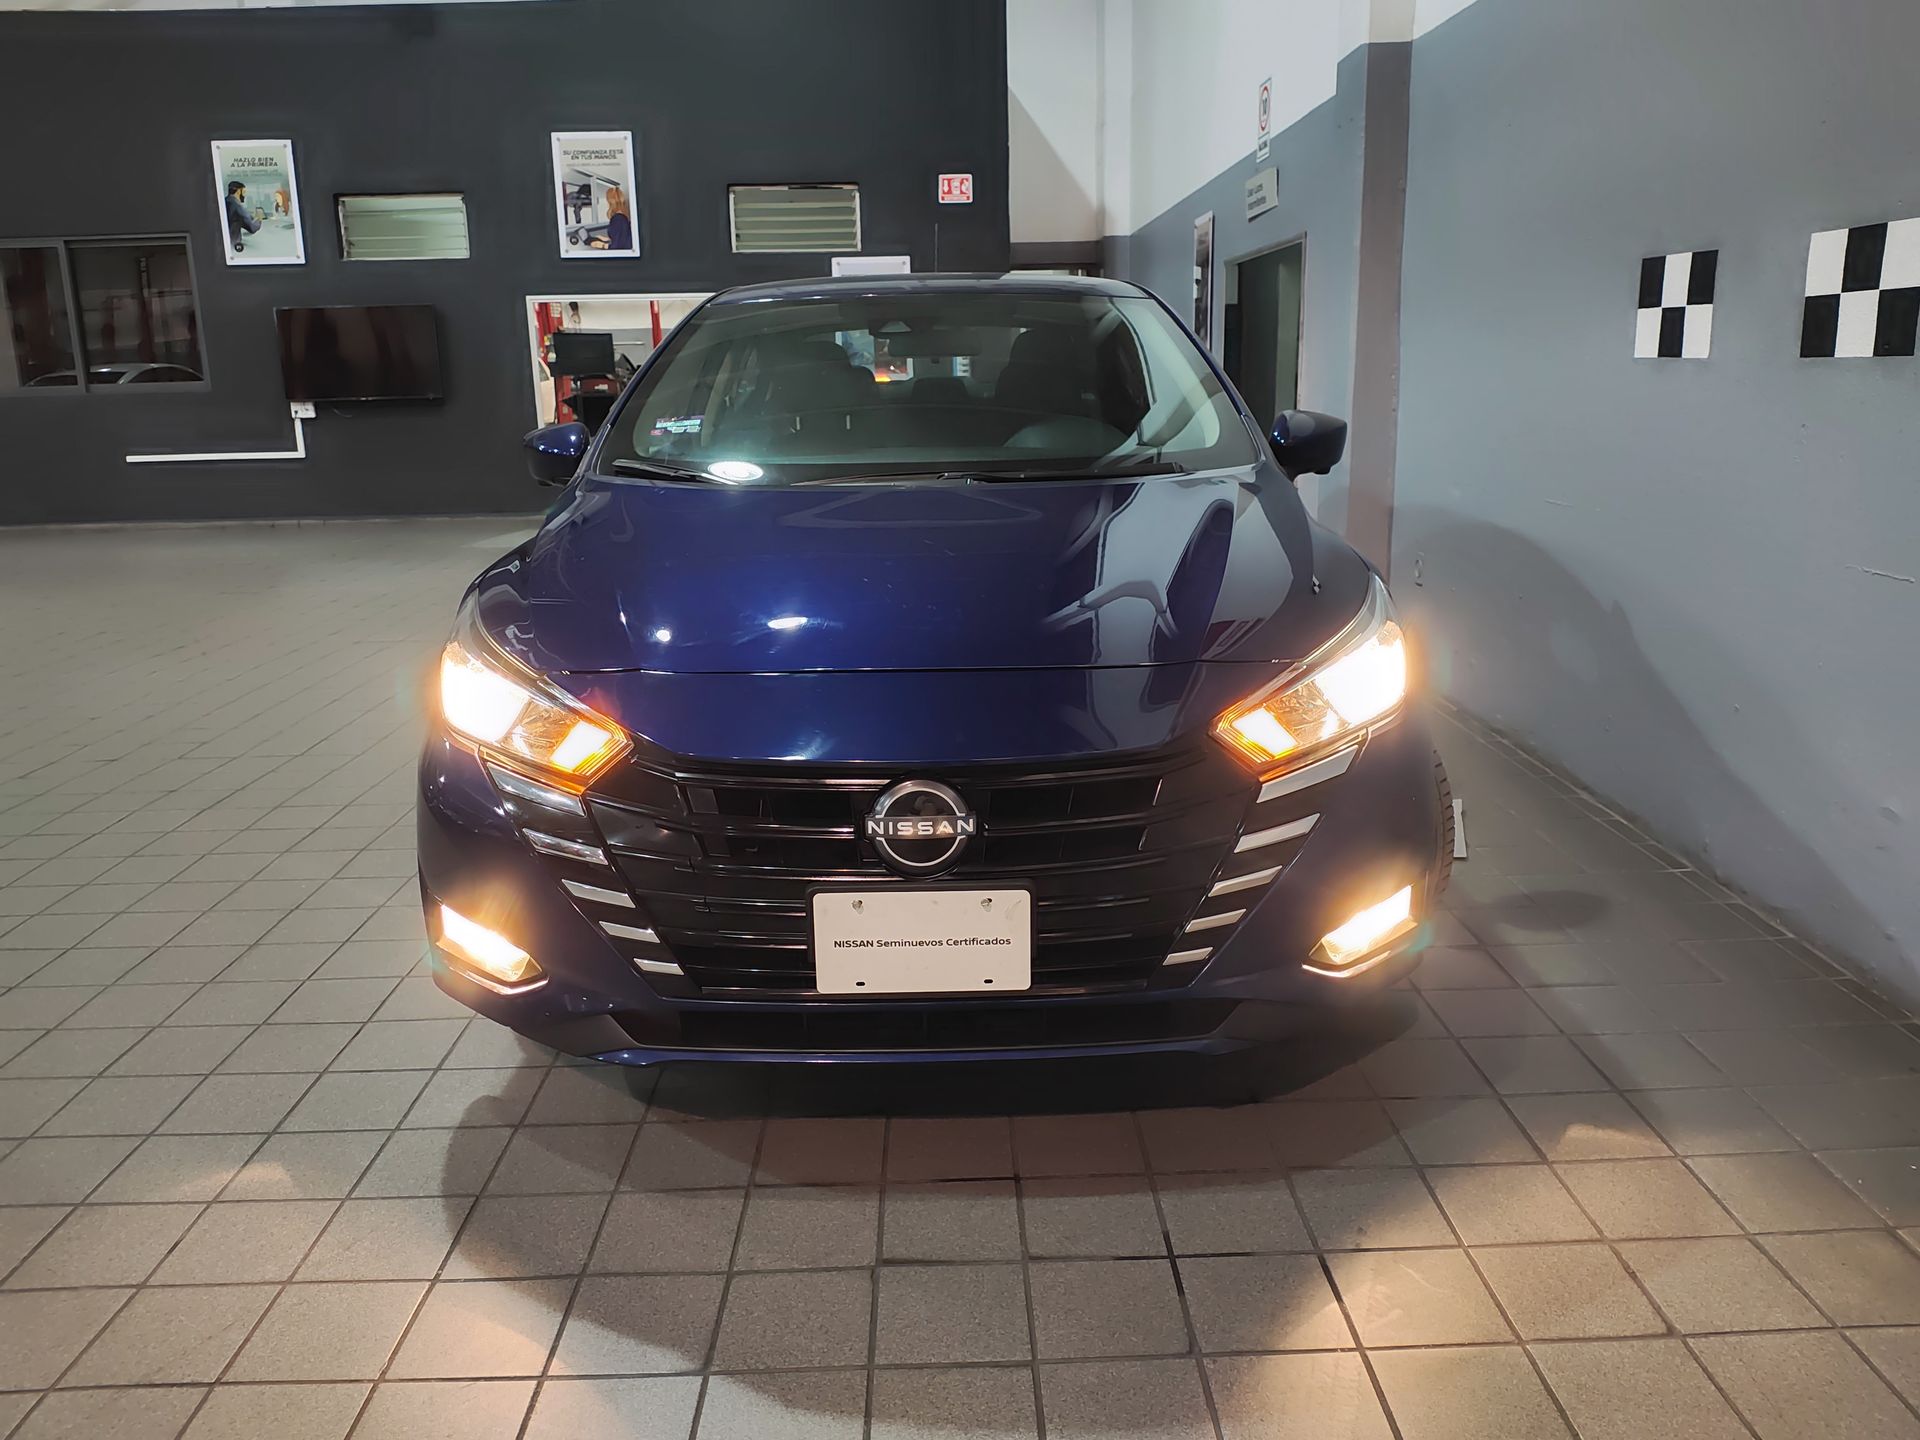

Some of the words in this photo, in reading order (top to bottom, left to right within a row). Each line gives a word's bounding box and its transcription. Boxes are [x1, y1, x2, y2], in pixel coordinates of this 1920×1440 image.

[867, 818, 974, 836] NISSAN
[833, 939, 875, 948] NISSAN
[876, 938, 944, 948] Seminuevos
[946, 937, 1012, 947] Certificados
